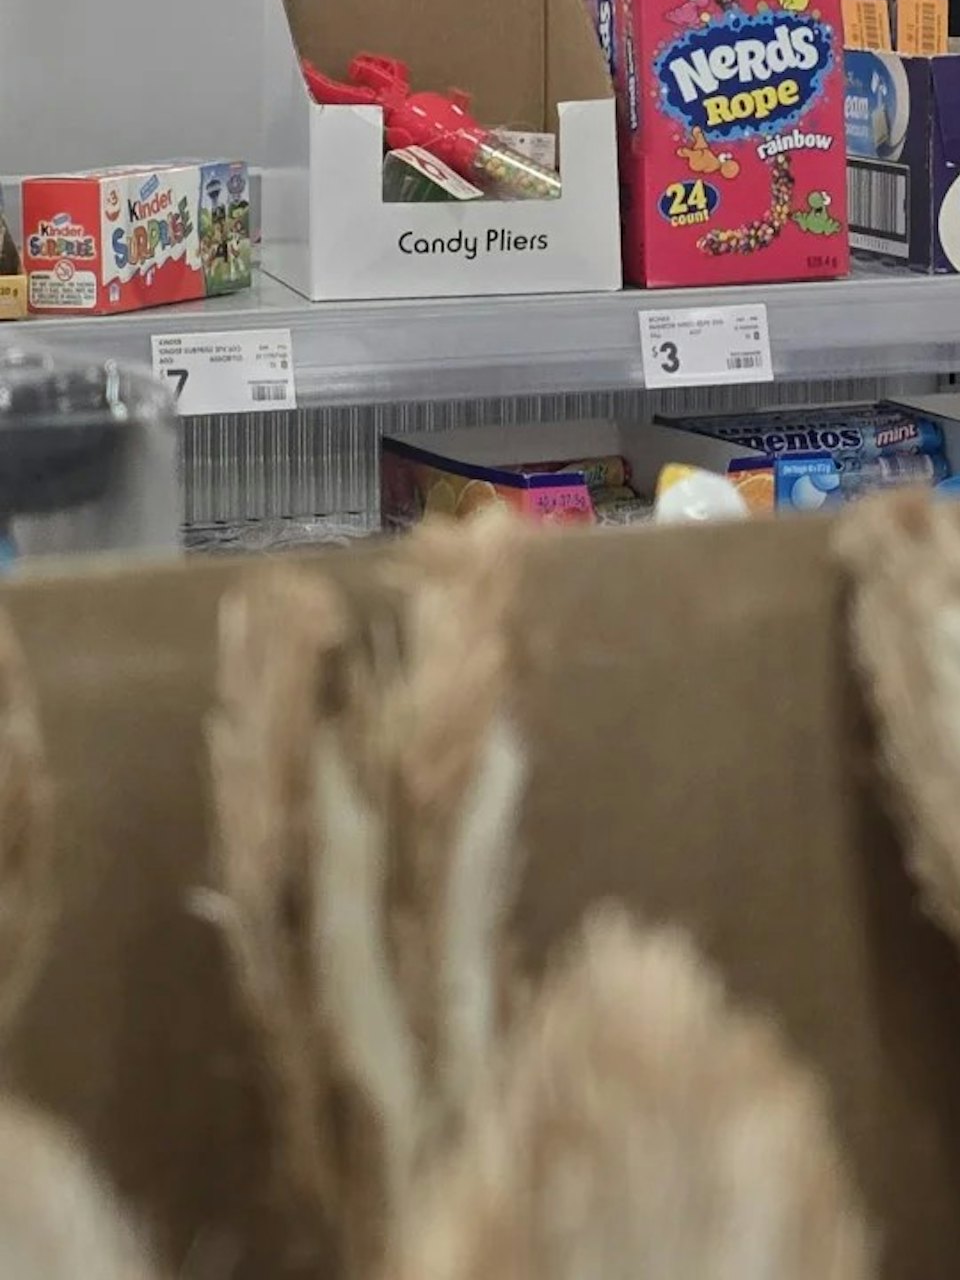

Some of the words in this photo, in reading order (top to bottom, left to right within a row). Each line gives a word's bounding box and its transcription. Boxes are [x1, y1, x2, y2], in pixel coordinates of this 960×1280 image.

[757, 131, 833, 161] rainbow
[666, 179, 709, 215] 24
[398, 230, 478, 259] Candy
[486, 229, 549, 252] Pliers
[875, 422, 919, 448] mint
